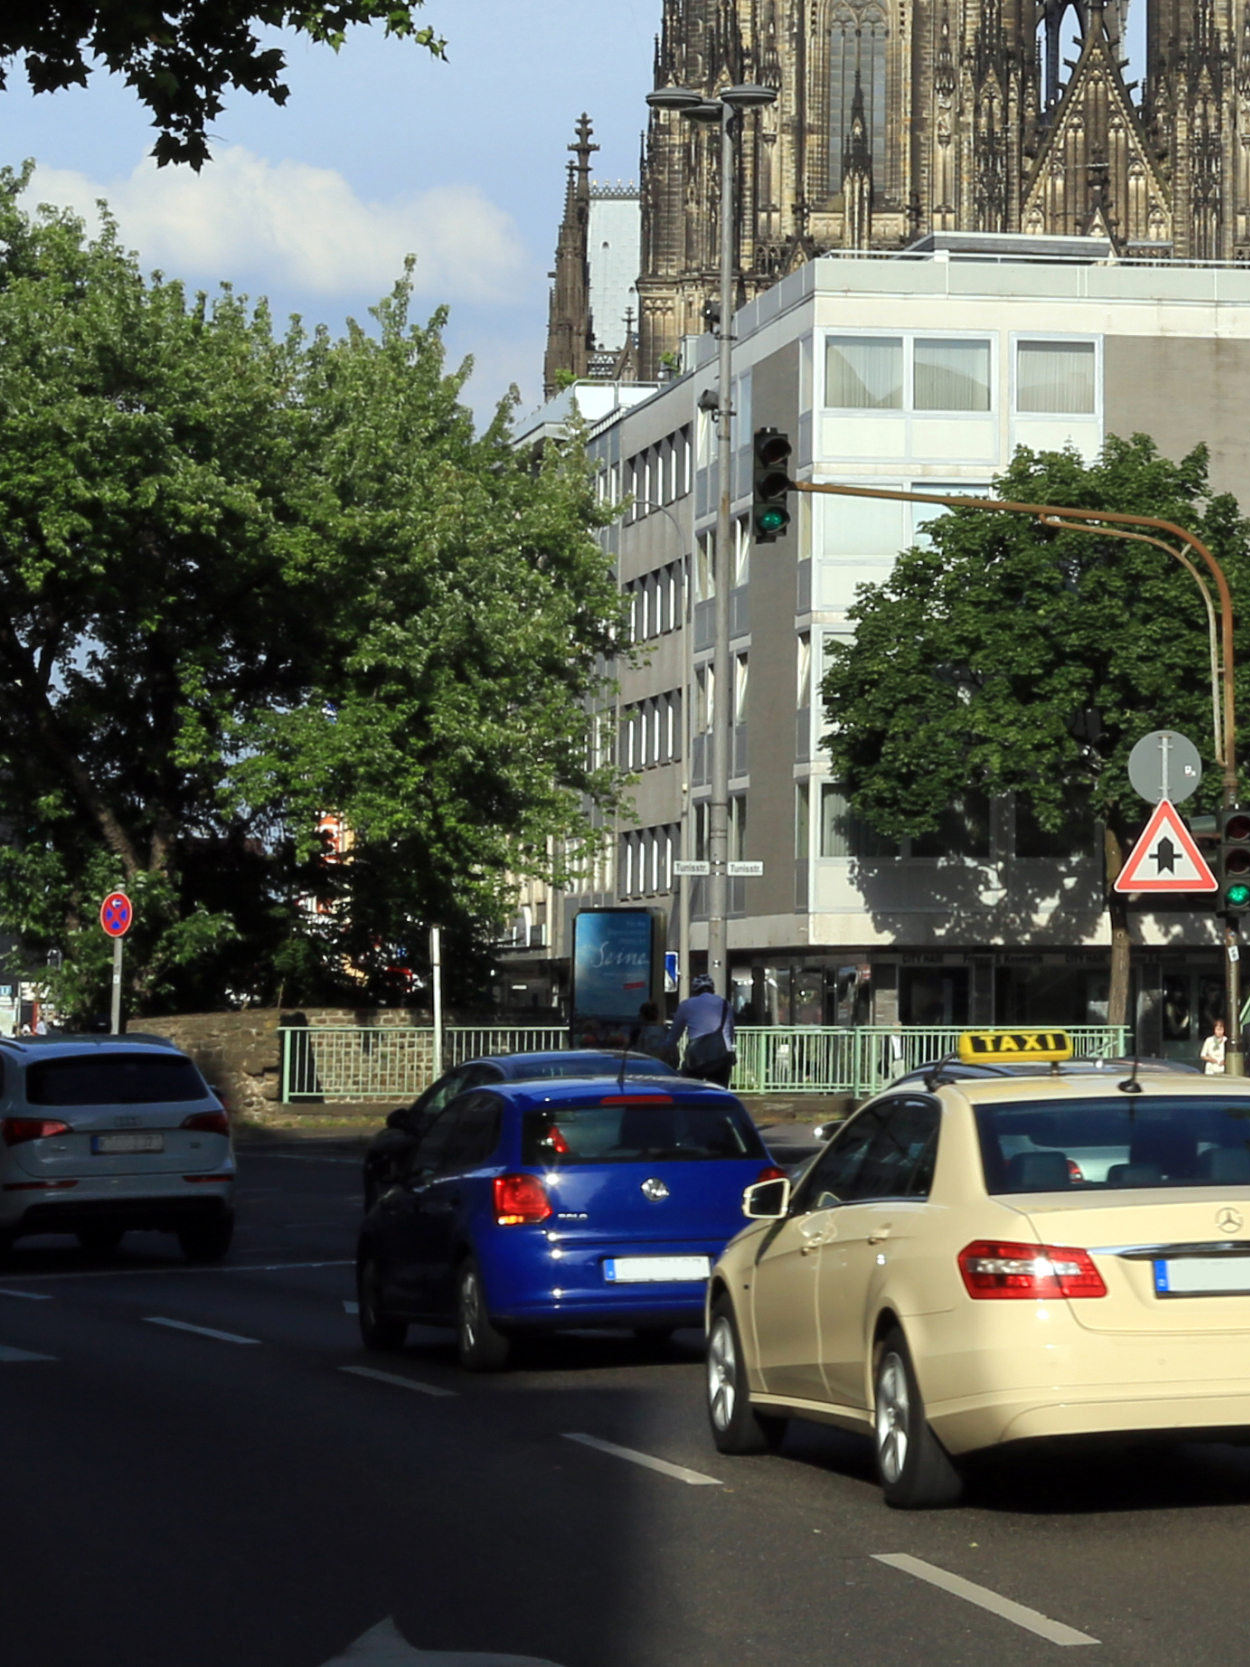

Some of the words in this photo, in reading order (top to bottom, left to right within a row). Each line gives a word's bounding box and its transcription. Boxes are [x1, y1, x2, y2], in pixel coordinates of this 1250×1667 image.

[675, 863, 708, 873] Tunisstr.
[729, 864, 762, 874] Tunisstr.
[979, 1034, 1056, 1052] TAXI
